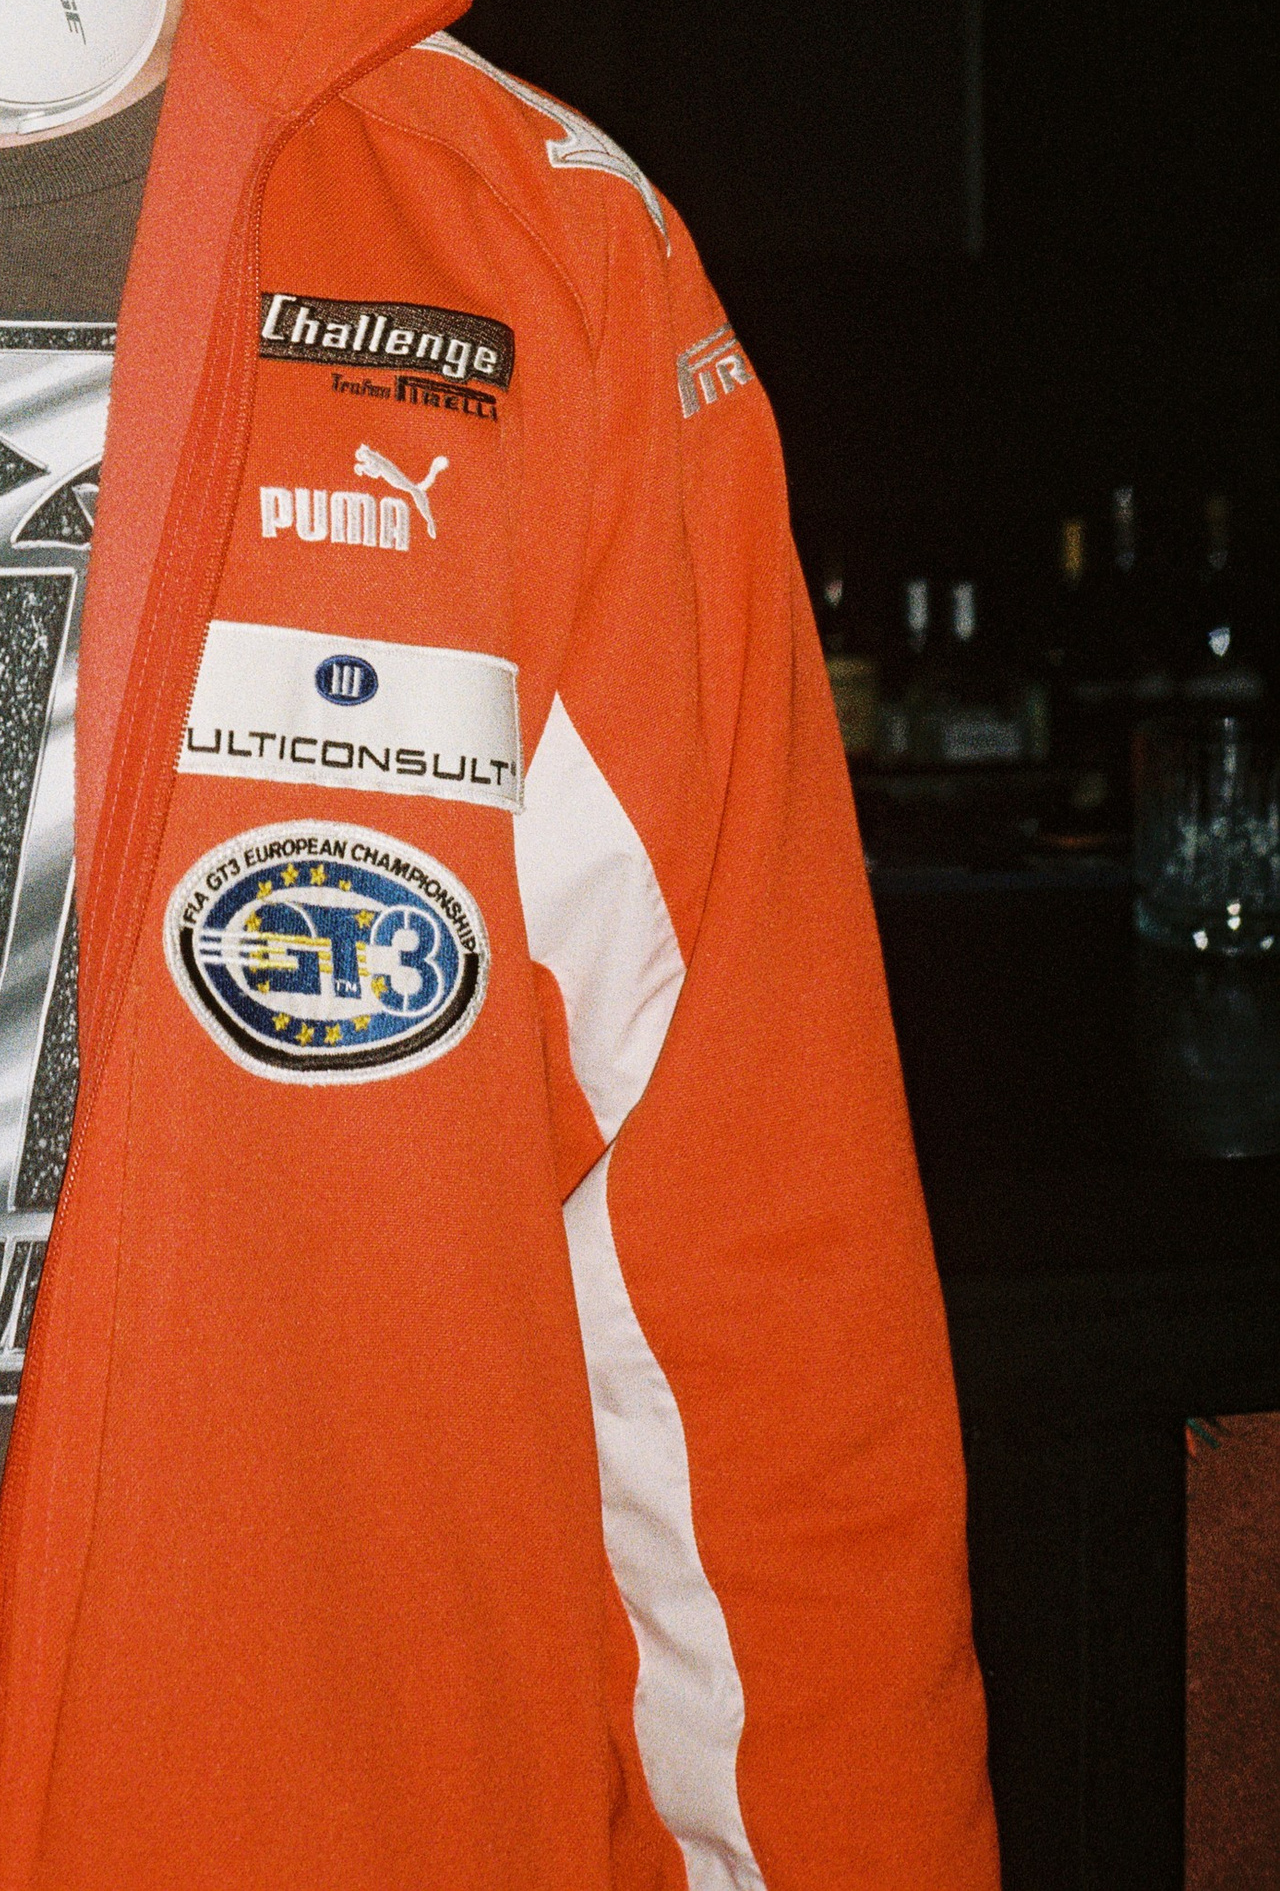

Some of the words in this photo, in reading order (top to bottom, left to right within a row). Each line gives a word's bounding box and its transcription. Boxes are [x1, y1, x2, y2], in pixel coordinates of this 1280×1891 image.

[261, 293, 498, 378] Challenge
[260, 486, 411, 551] PUMA
[186, 727, 517, 786] ULTICONSULT
[184, 891, 209, 924] FIA
[206, 857, 241, 892] GT3
[244, 837, 347, 867] EUROPEAN
[351, 842, 478, 951] CHAMPIONSHIP
